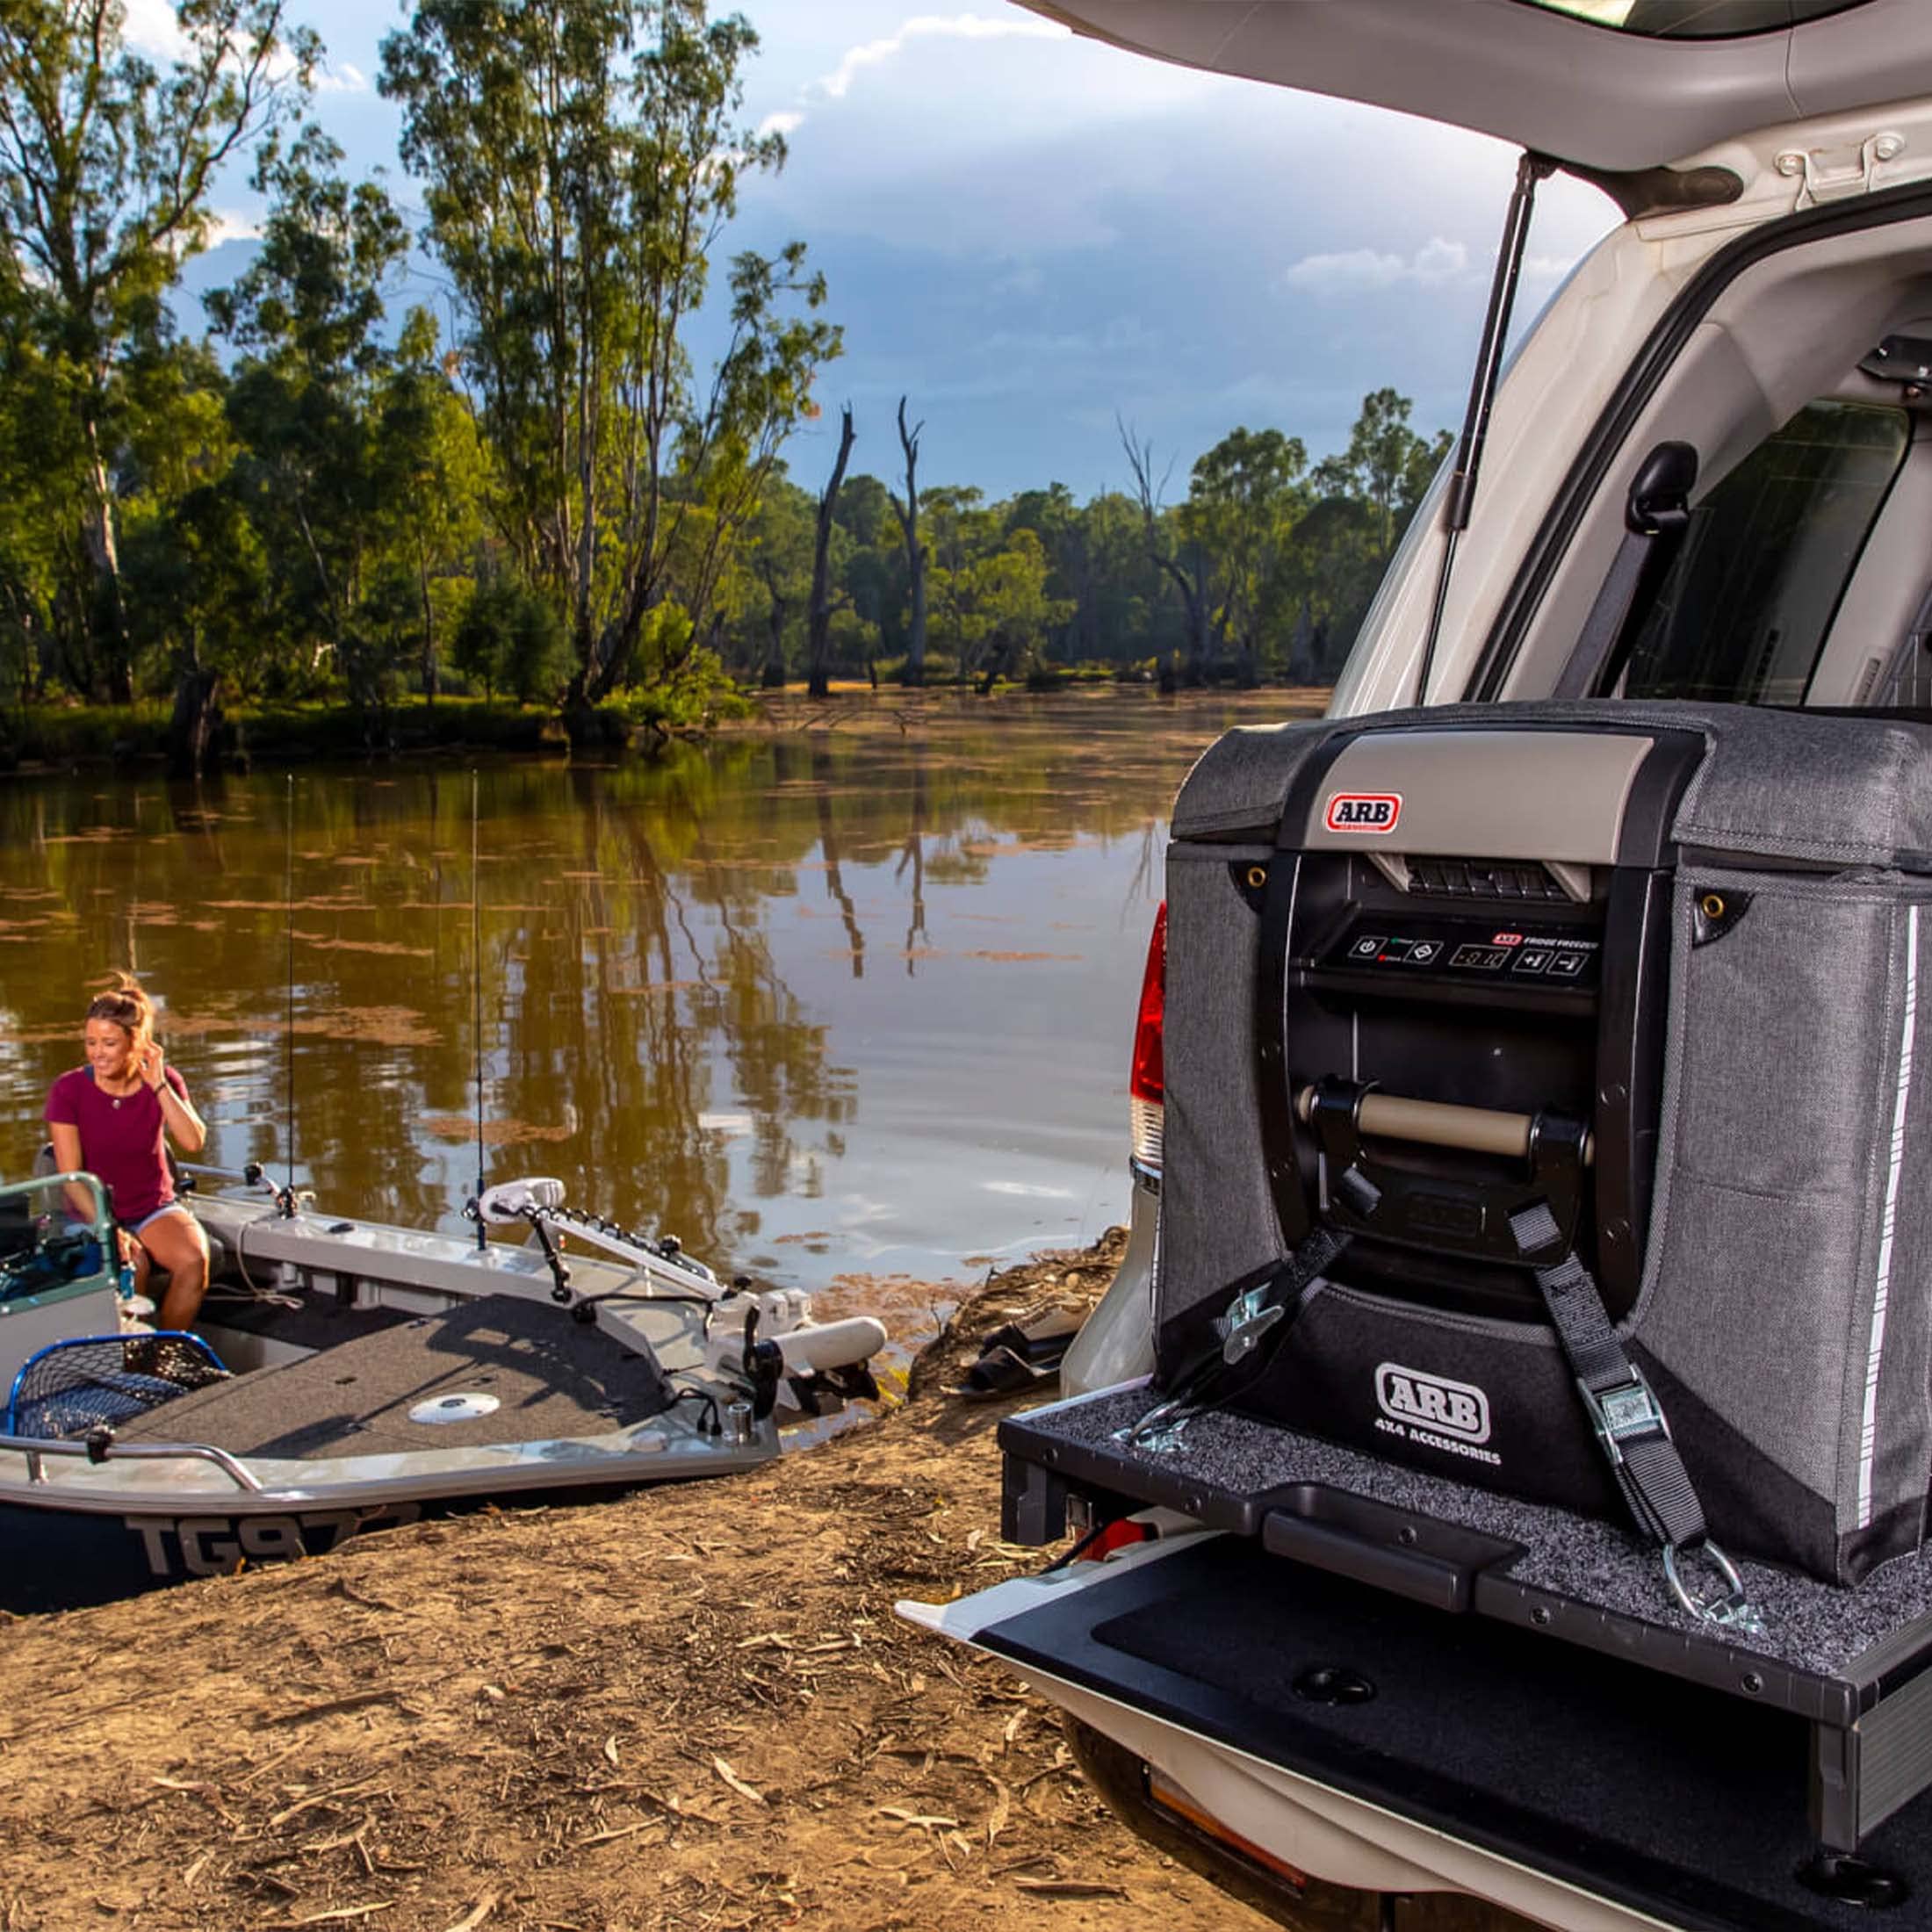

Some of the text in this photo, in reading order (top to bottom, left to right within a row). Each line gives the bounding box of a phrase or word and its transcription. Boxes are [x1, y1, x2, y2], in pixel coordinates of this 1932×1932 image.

[1336, 803, 1390, 824] ARB
[1524, 936, 1557, 947] FRIDGE
[1558, 939, 1599, 949] FREEZER
[1390, 1375, 1480, 1431] ARB
[1409, 1428, 1503, 1466] ACCESSORIES
